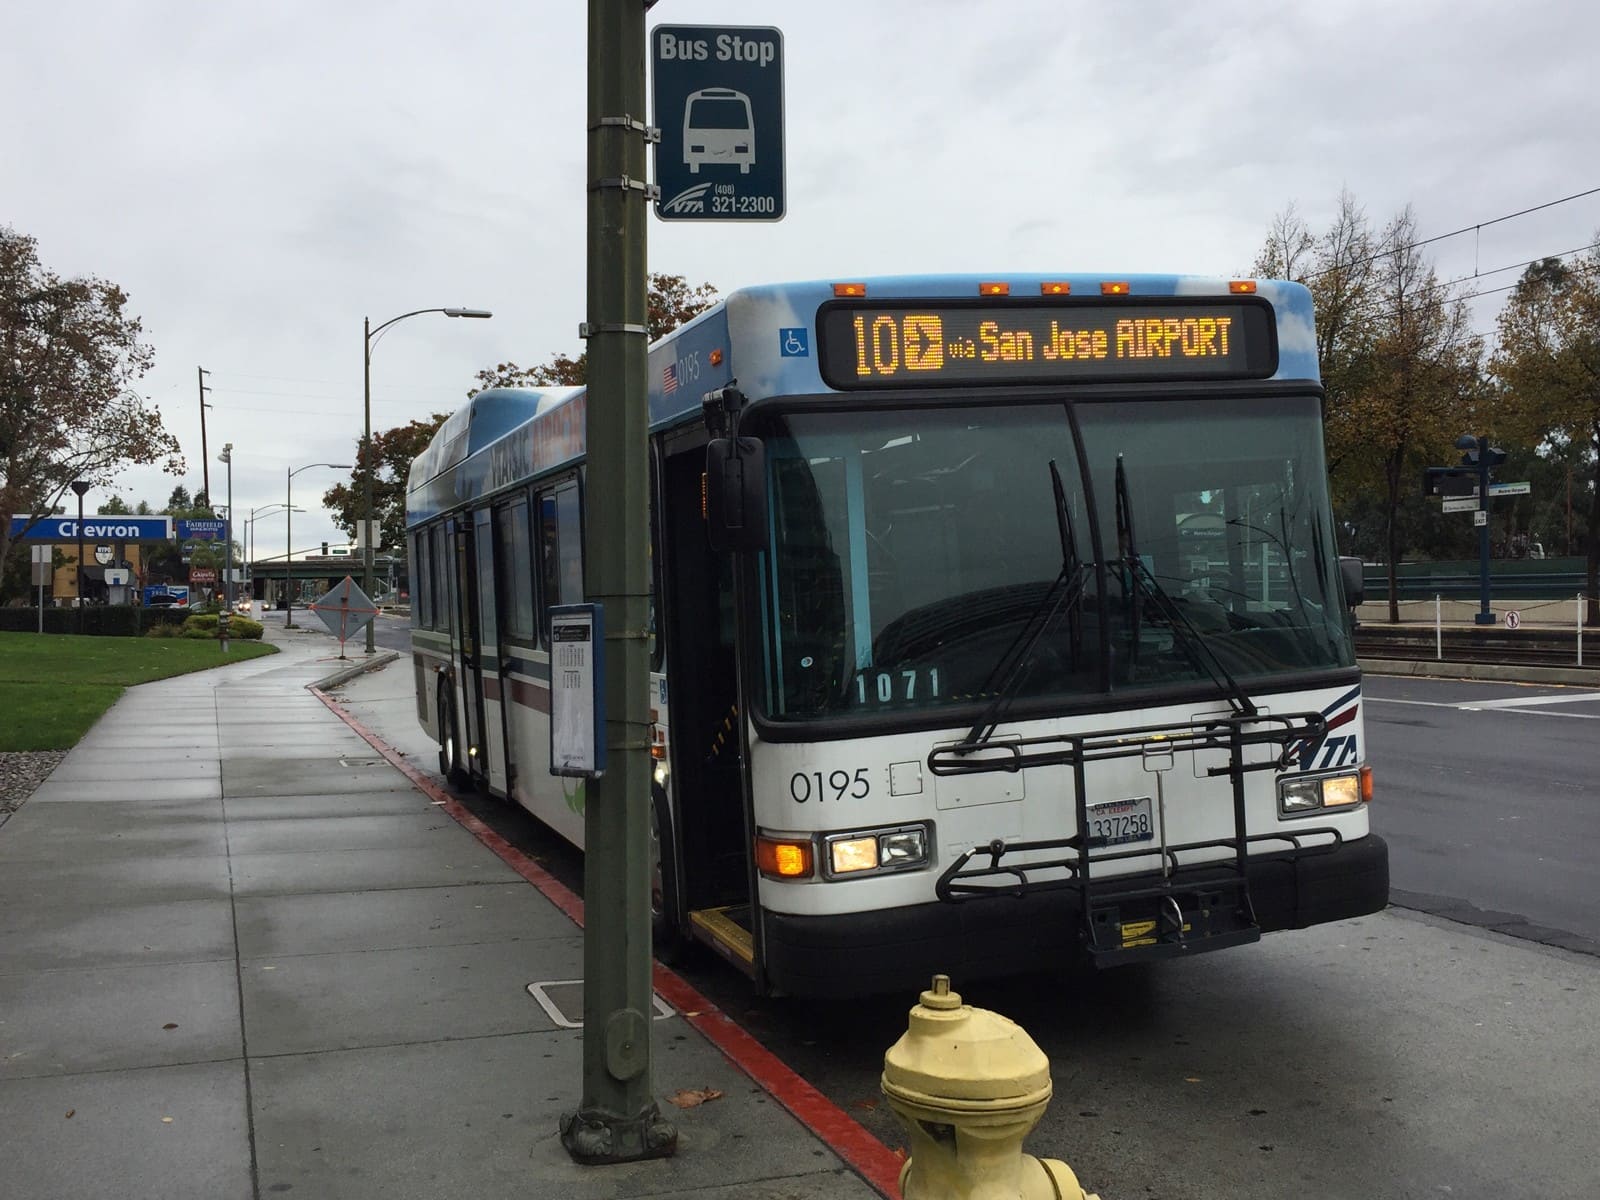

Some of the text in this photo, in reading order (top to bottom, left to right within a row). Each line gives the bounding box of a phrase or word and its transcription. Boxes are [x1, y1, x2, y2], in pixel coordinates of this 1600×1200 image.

[660, 34, 774, 67] Bus Stop
[714, 184, 735, 195] (408)
[712, 196, 775, 213] 321-2300
[854, 316, 1231, 375] 10 via San Jose AIRPORT
[679, 351, 700, 386] 0195
[58, 522, 140, 537] Chevron
[185, 520, 223, 528] FAIRFIELD
[856, 668, 939, 703] 1071
[790, 768, 870, 803] 0195
[1087, 813, 1148, 838] 1337258
